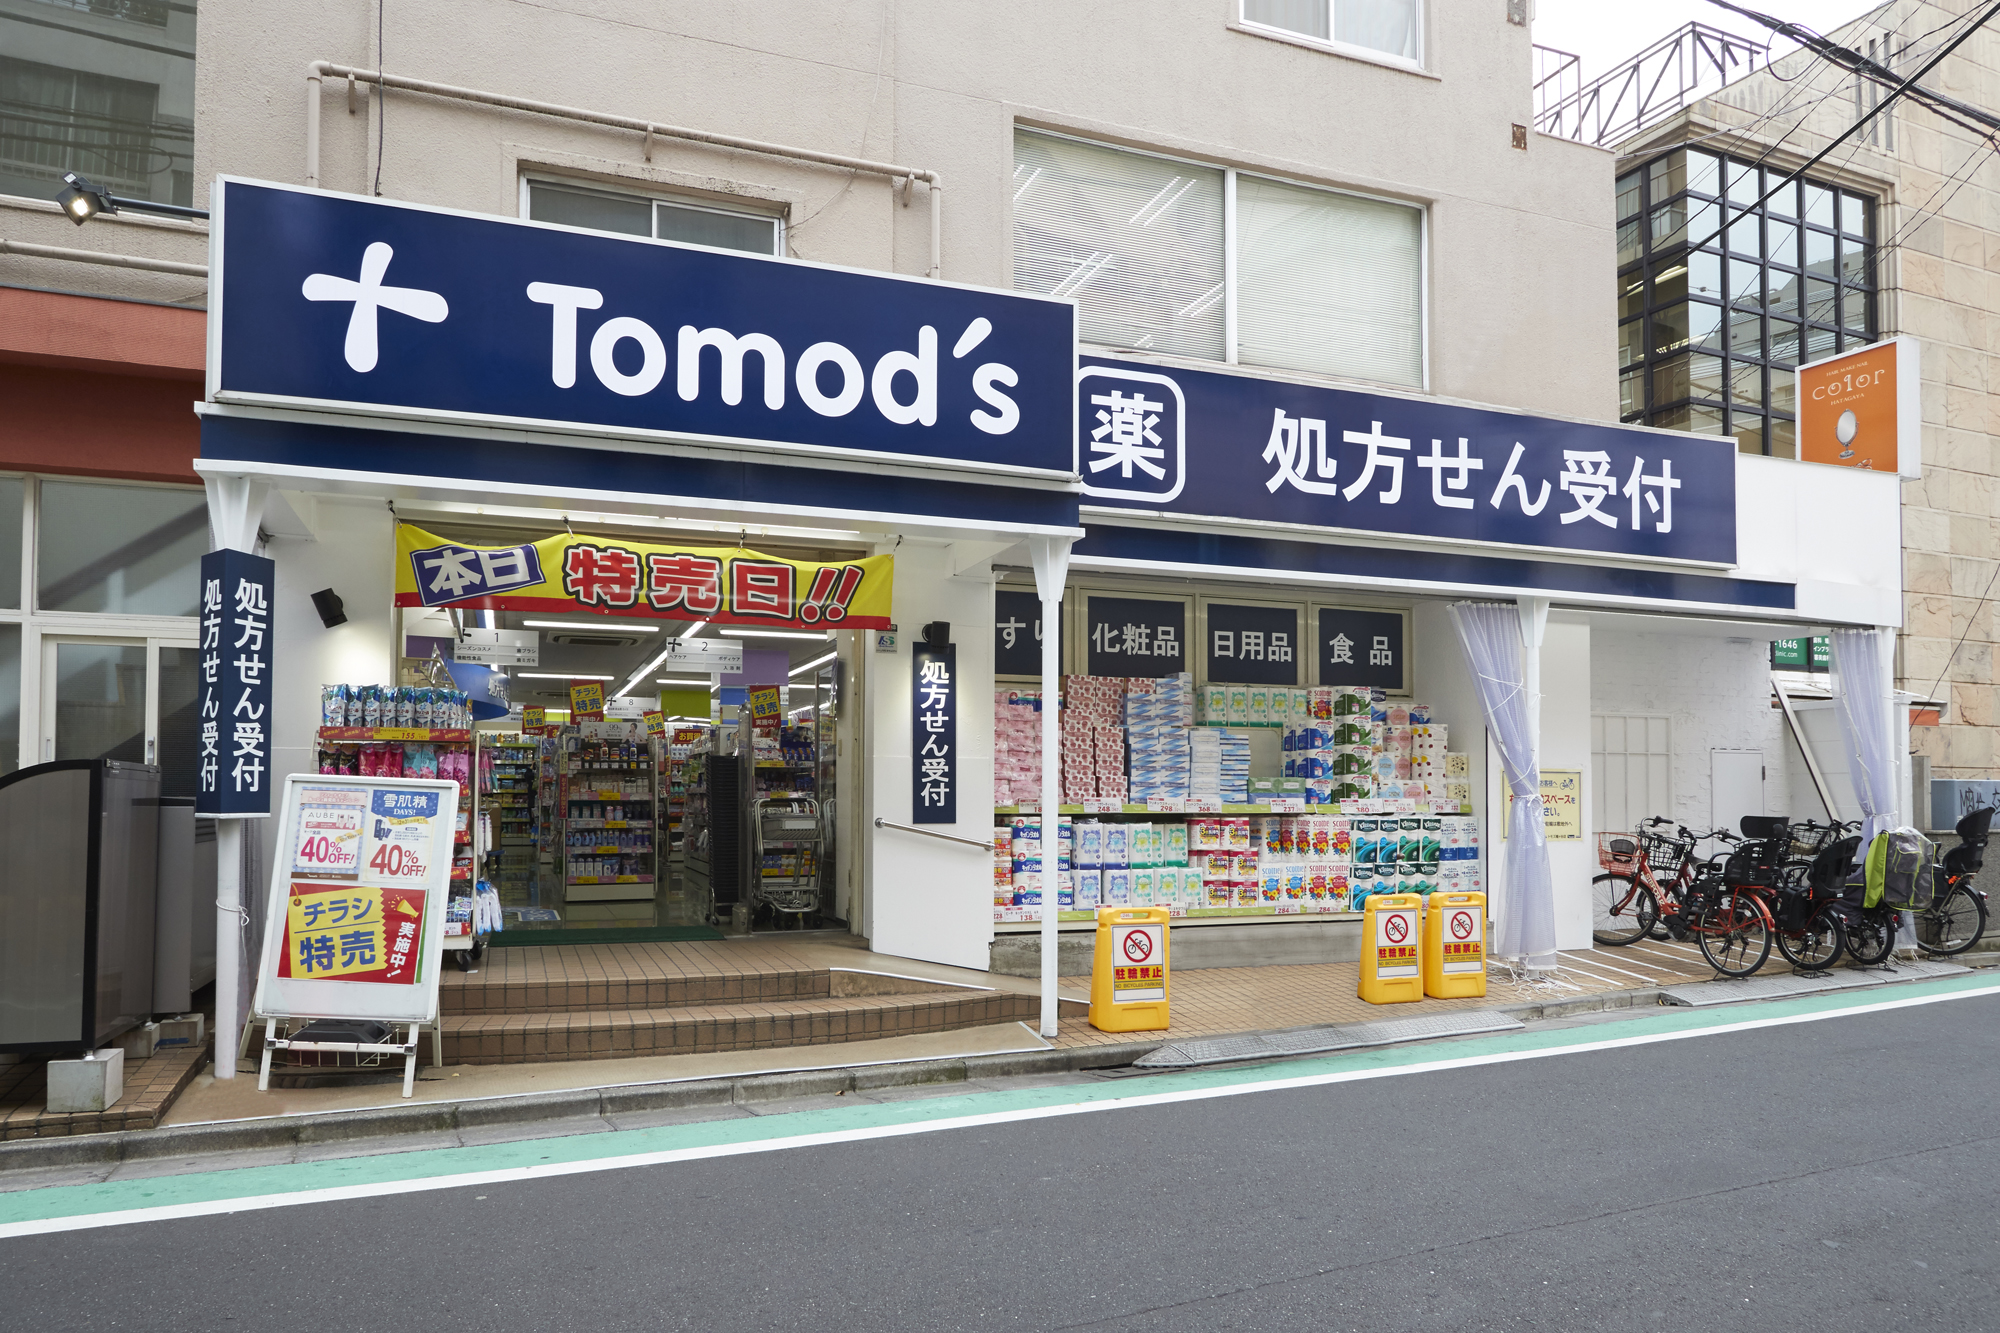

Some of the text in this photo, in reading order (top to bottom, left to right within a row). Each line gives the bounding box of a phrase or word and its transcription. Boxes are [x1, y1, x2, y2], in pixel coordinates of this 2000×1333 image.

[526, 281, 1020, 435] Tomod's
[1826, 369, 1839, 377] HAIR
[1840, 365, 1855, 373] MAKE
[1812, 369, 1885, 400] color
[1830, 393, 1865, 405] HATAGAYA
[1088, 389, 1167, 481] 薬
[1262, 407, 1682, 534] 処方せん受付
[423, 543, 865, 624] 本日 特売日!!
[494, 632, 499, 643] 1
[701, 641, 709, 652] 2
[1091, 622, 1180, 658] 化粧品
[1213, 629, 1293, 662] 日用品
[1329, 632, 1393, 666] 食品
[200, 578, 223, 793] 処方せん受付
[231, 577, 269, 793] 処方せん受付
[575, 686, 598, 697] チラシ
[753, 691, 775, 702] チラシ
[575, 698, 601, 712] 特売
[754, 701, 779, 716] 特売
[401, 732, 415, 740] 155
[919, 659, 950, 808] 処方せん受付
[383, 793, 428, 809] 雪肌精
[393, 808, 416, 816] DAYS!
[300, 836, 342, 863] 40%
[328, 853, 355, 864] OFF!
[369, 844, 427, 877] 40% OFF!
[303, 896, 374, 928] チラシ
[299, 929, 377, 973] 特売
[386, 921, 417, 979] 実施中!
[1378, 946, 1417, 959] 駐輪禁止
[1444, 943, 1481, 955] 駐輪禁止
[1115, 966, 1163, 981] 駐輪禁止
